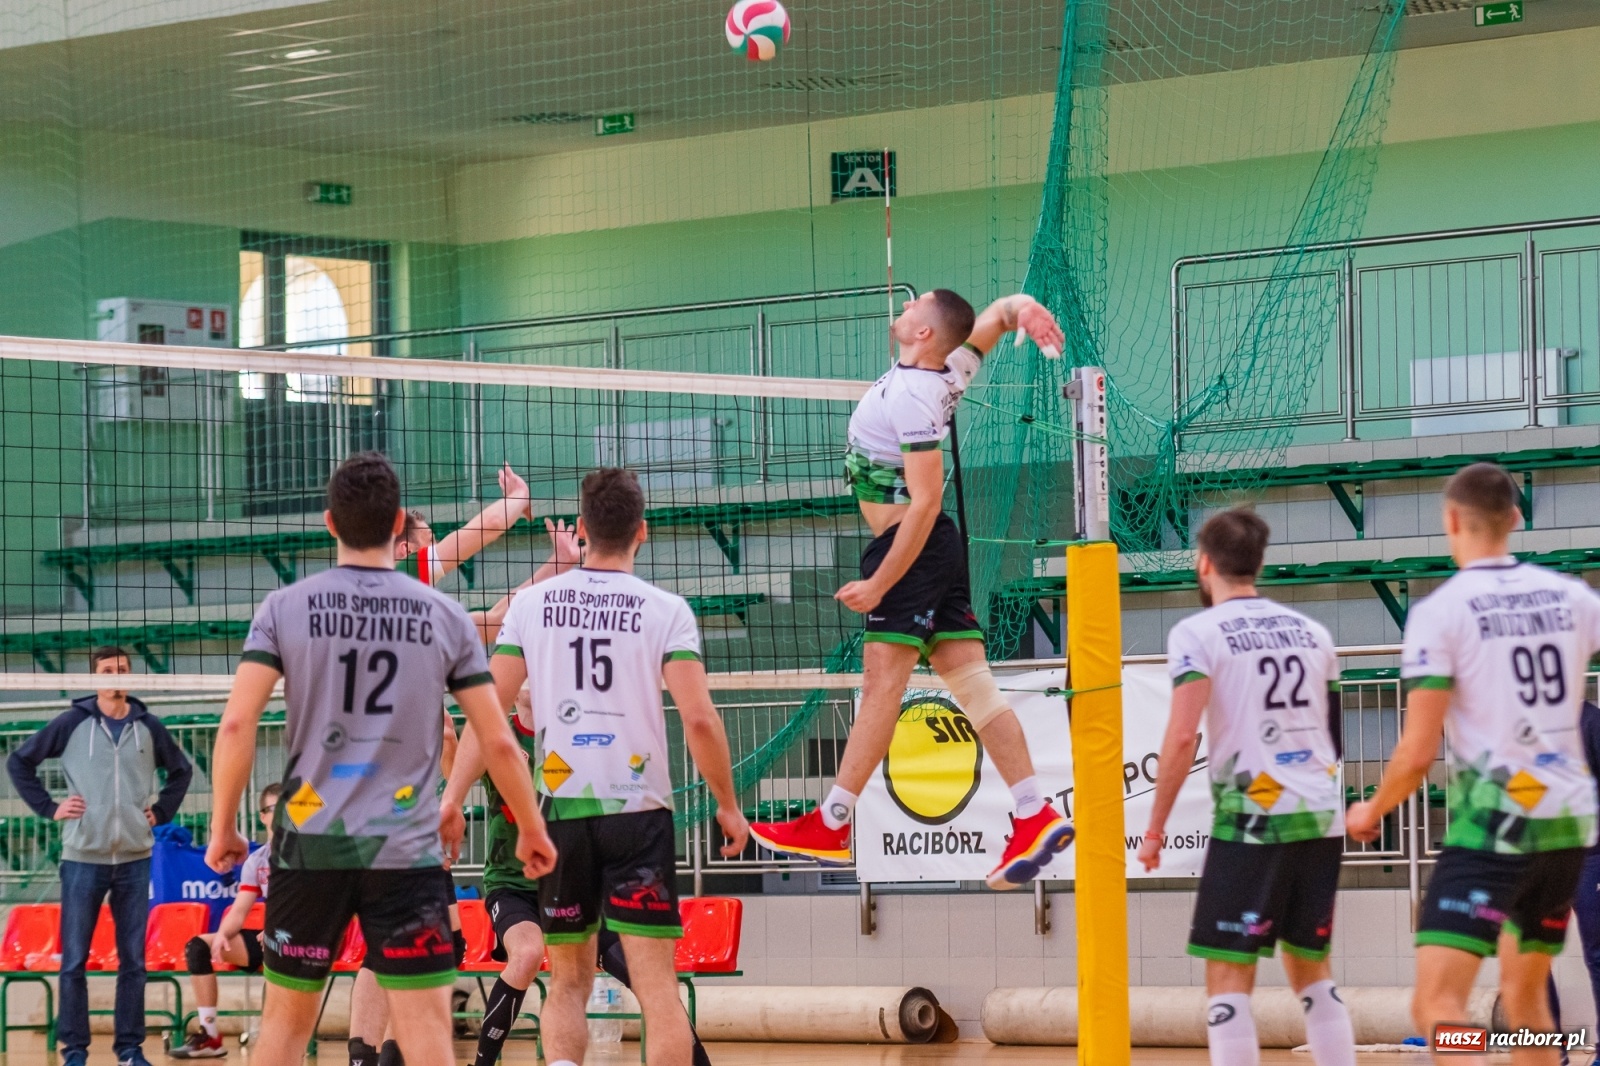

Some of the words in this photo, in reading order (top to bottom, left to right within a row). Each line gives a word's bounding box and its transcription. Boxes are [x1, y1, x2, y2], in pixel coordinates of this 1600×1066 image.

[844, 155, 881, 163] SEKTOR
[842, 168, 885, 192] A
[308, 592, 347, 611] KLUB
[351, 595, 432, 618] SPORTOWY
[544, 589, 576, 604] KLUB
[579, 591, 646, 609] SPORTOWY
[310, 612, 433, 646] RUDZINIEC
[543, 605, 642, 633] RUDZINIEC
[1218, 617, 1248, 633] KLUB
[1226, 629, 1318, 656] RUDZINIEC
[569, 636, 613, 693] 15
[1512, 643, 1567, 707] 99
[338, 648, 398, 715] 12
[1258, 654, 1309, 711] 22
[571, 733, 616, 746] SFD
[882, 826, 986, 855] RACIBÓRZ
[283, 944, 330, 960] BURGER
